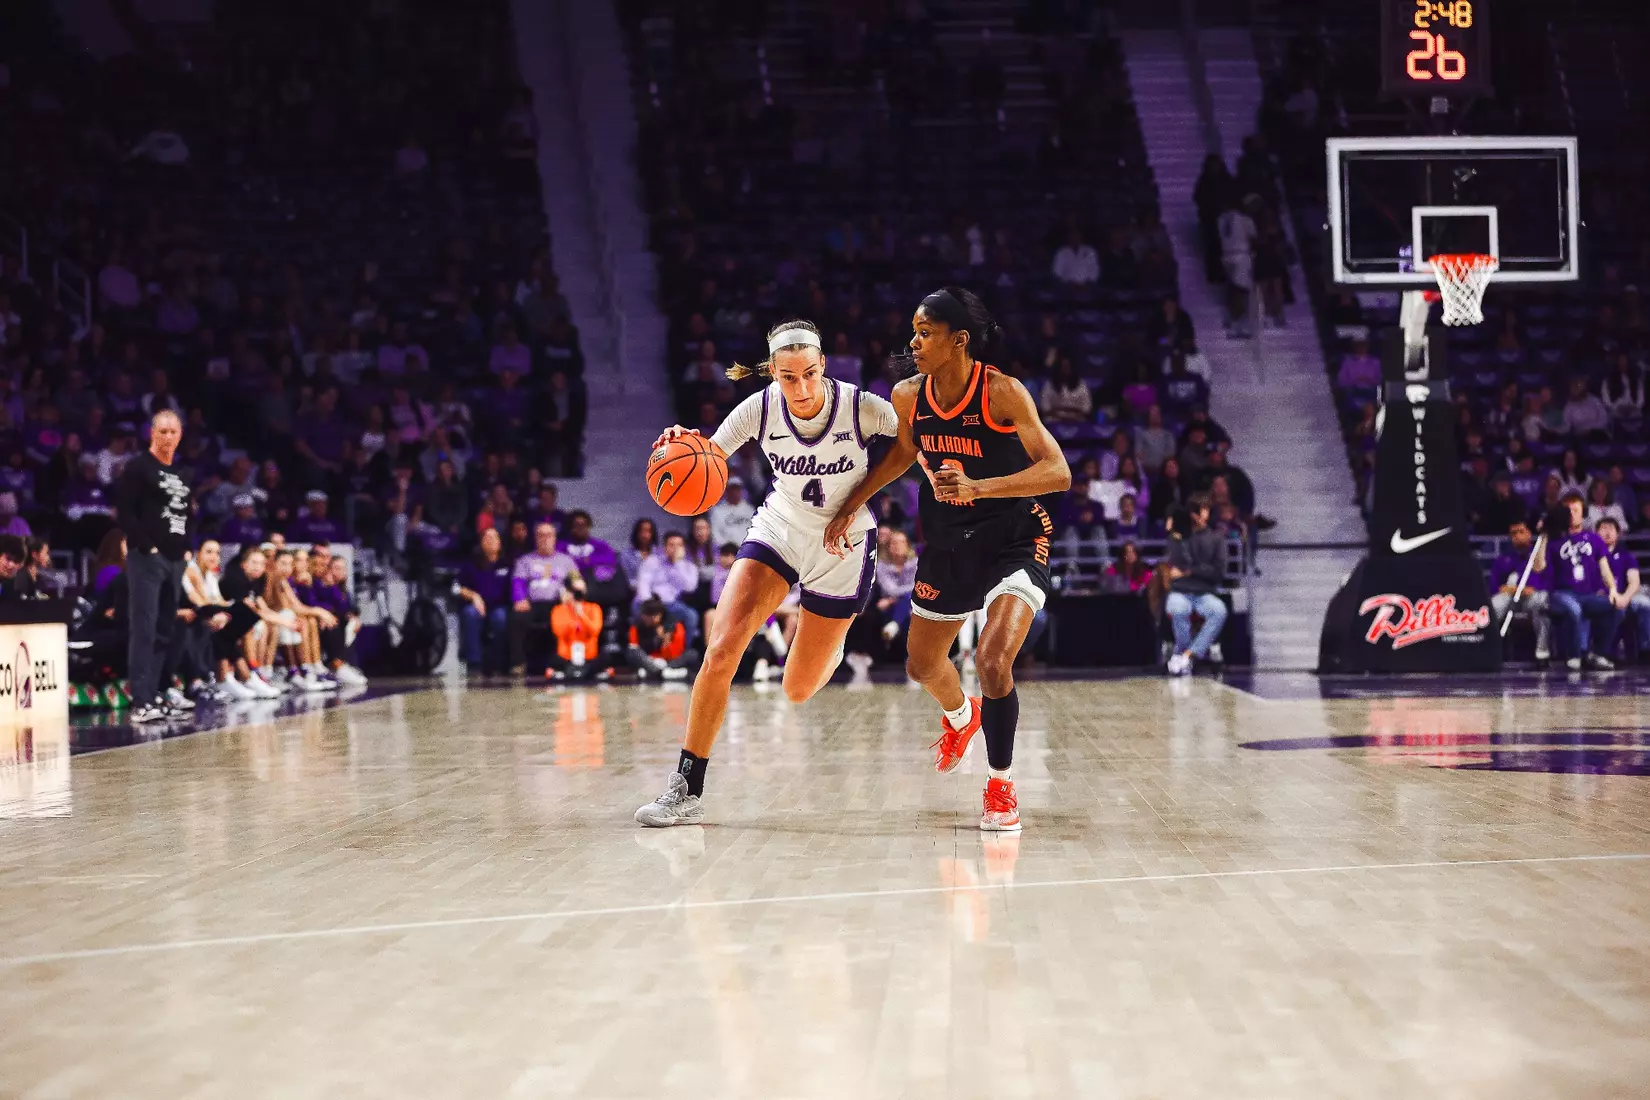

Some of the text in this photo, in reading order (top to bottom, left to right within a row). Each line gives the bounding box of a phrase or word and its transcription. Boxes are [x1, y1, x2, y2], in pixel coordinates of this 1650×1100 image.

[1415, 0, 1472, 28] 2:48
[1406, 30, 1466, 80] 26
[920, 435, 983, 458] OKLAHOMA
[769, 452, 856, 475] Wildcats
[1412, 407, 1427, 524] WILDCATS
[801, 478, 825, 508] 4
[1358, 593, 1490, 646] Dillons
[35, 660, 57, 692] BELL
